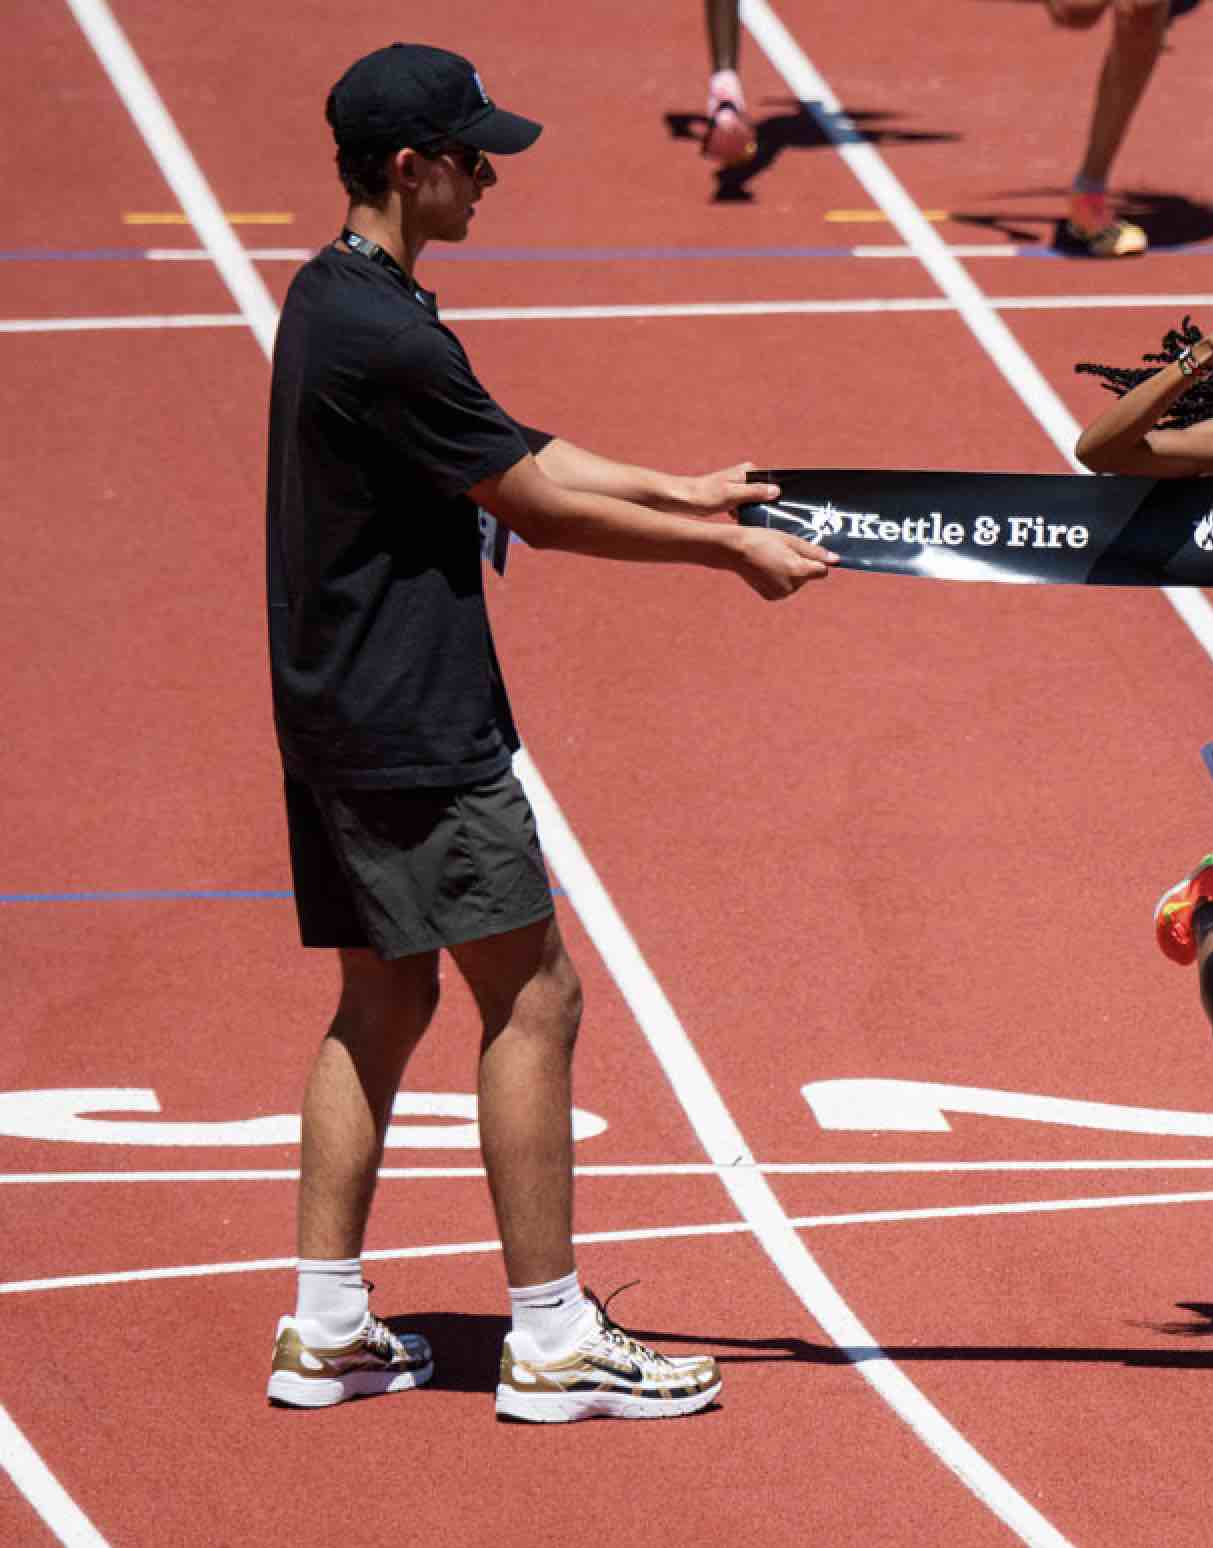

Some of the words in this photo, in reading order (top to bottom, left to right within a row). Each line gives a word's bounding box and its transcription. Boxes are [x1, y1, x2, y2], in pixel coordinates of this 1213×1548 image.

[847, 511, 965, 543] Kettle
[973, 515, 1000, 546] &
[1006, 515, 1089, 548] Fire
